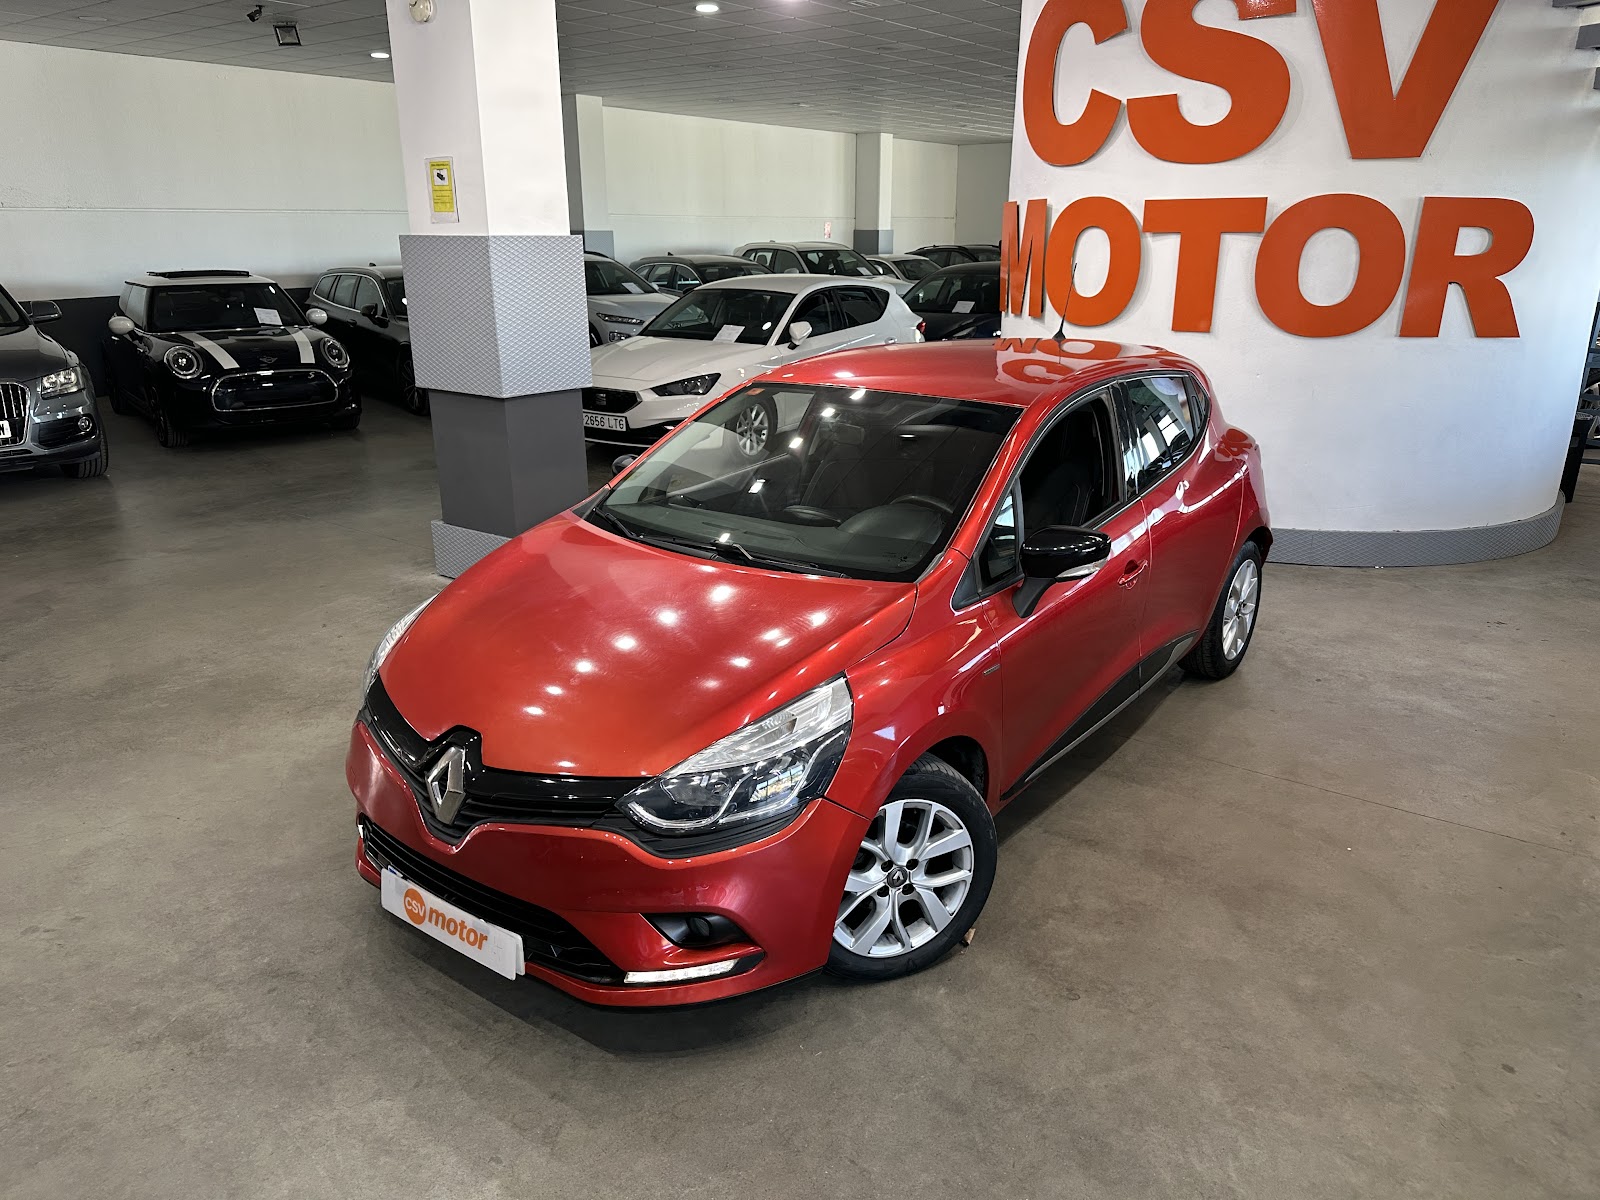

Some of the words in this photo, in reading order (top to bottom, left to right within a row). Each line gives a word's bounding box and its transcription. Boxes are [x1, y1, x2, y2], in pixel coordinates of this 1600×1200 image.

[1023, 0, 1499, 166] CSV
[1000, 194, 1534, 338] MOTOR
[584, 414, 605, 427] 2656
[404, 896, 426, 917] CSV
[428, 906, 488, 951] motor
